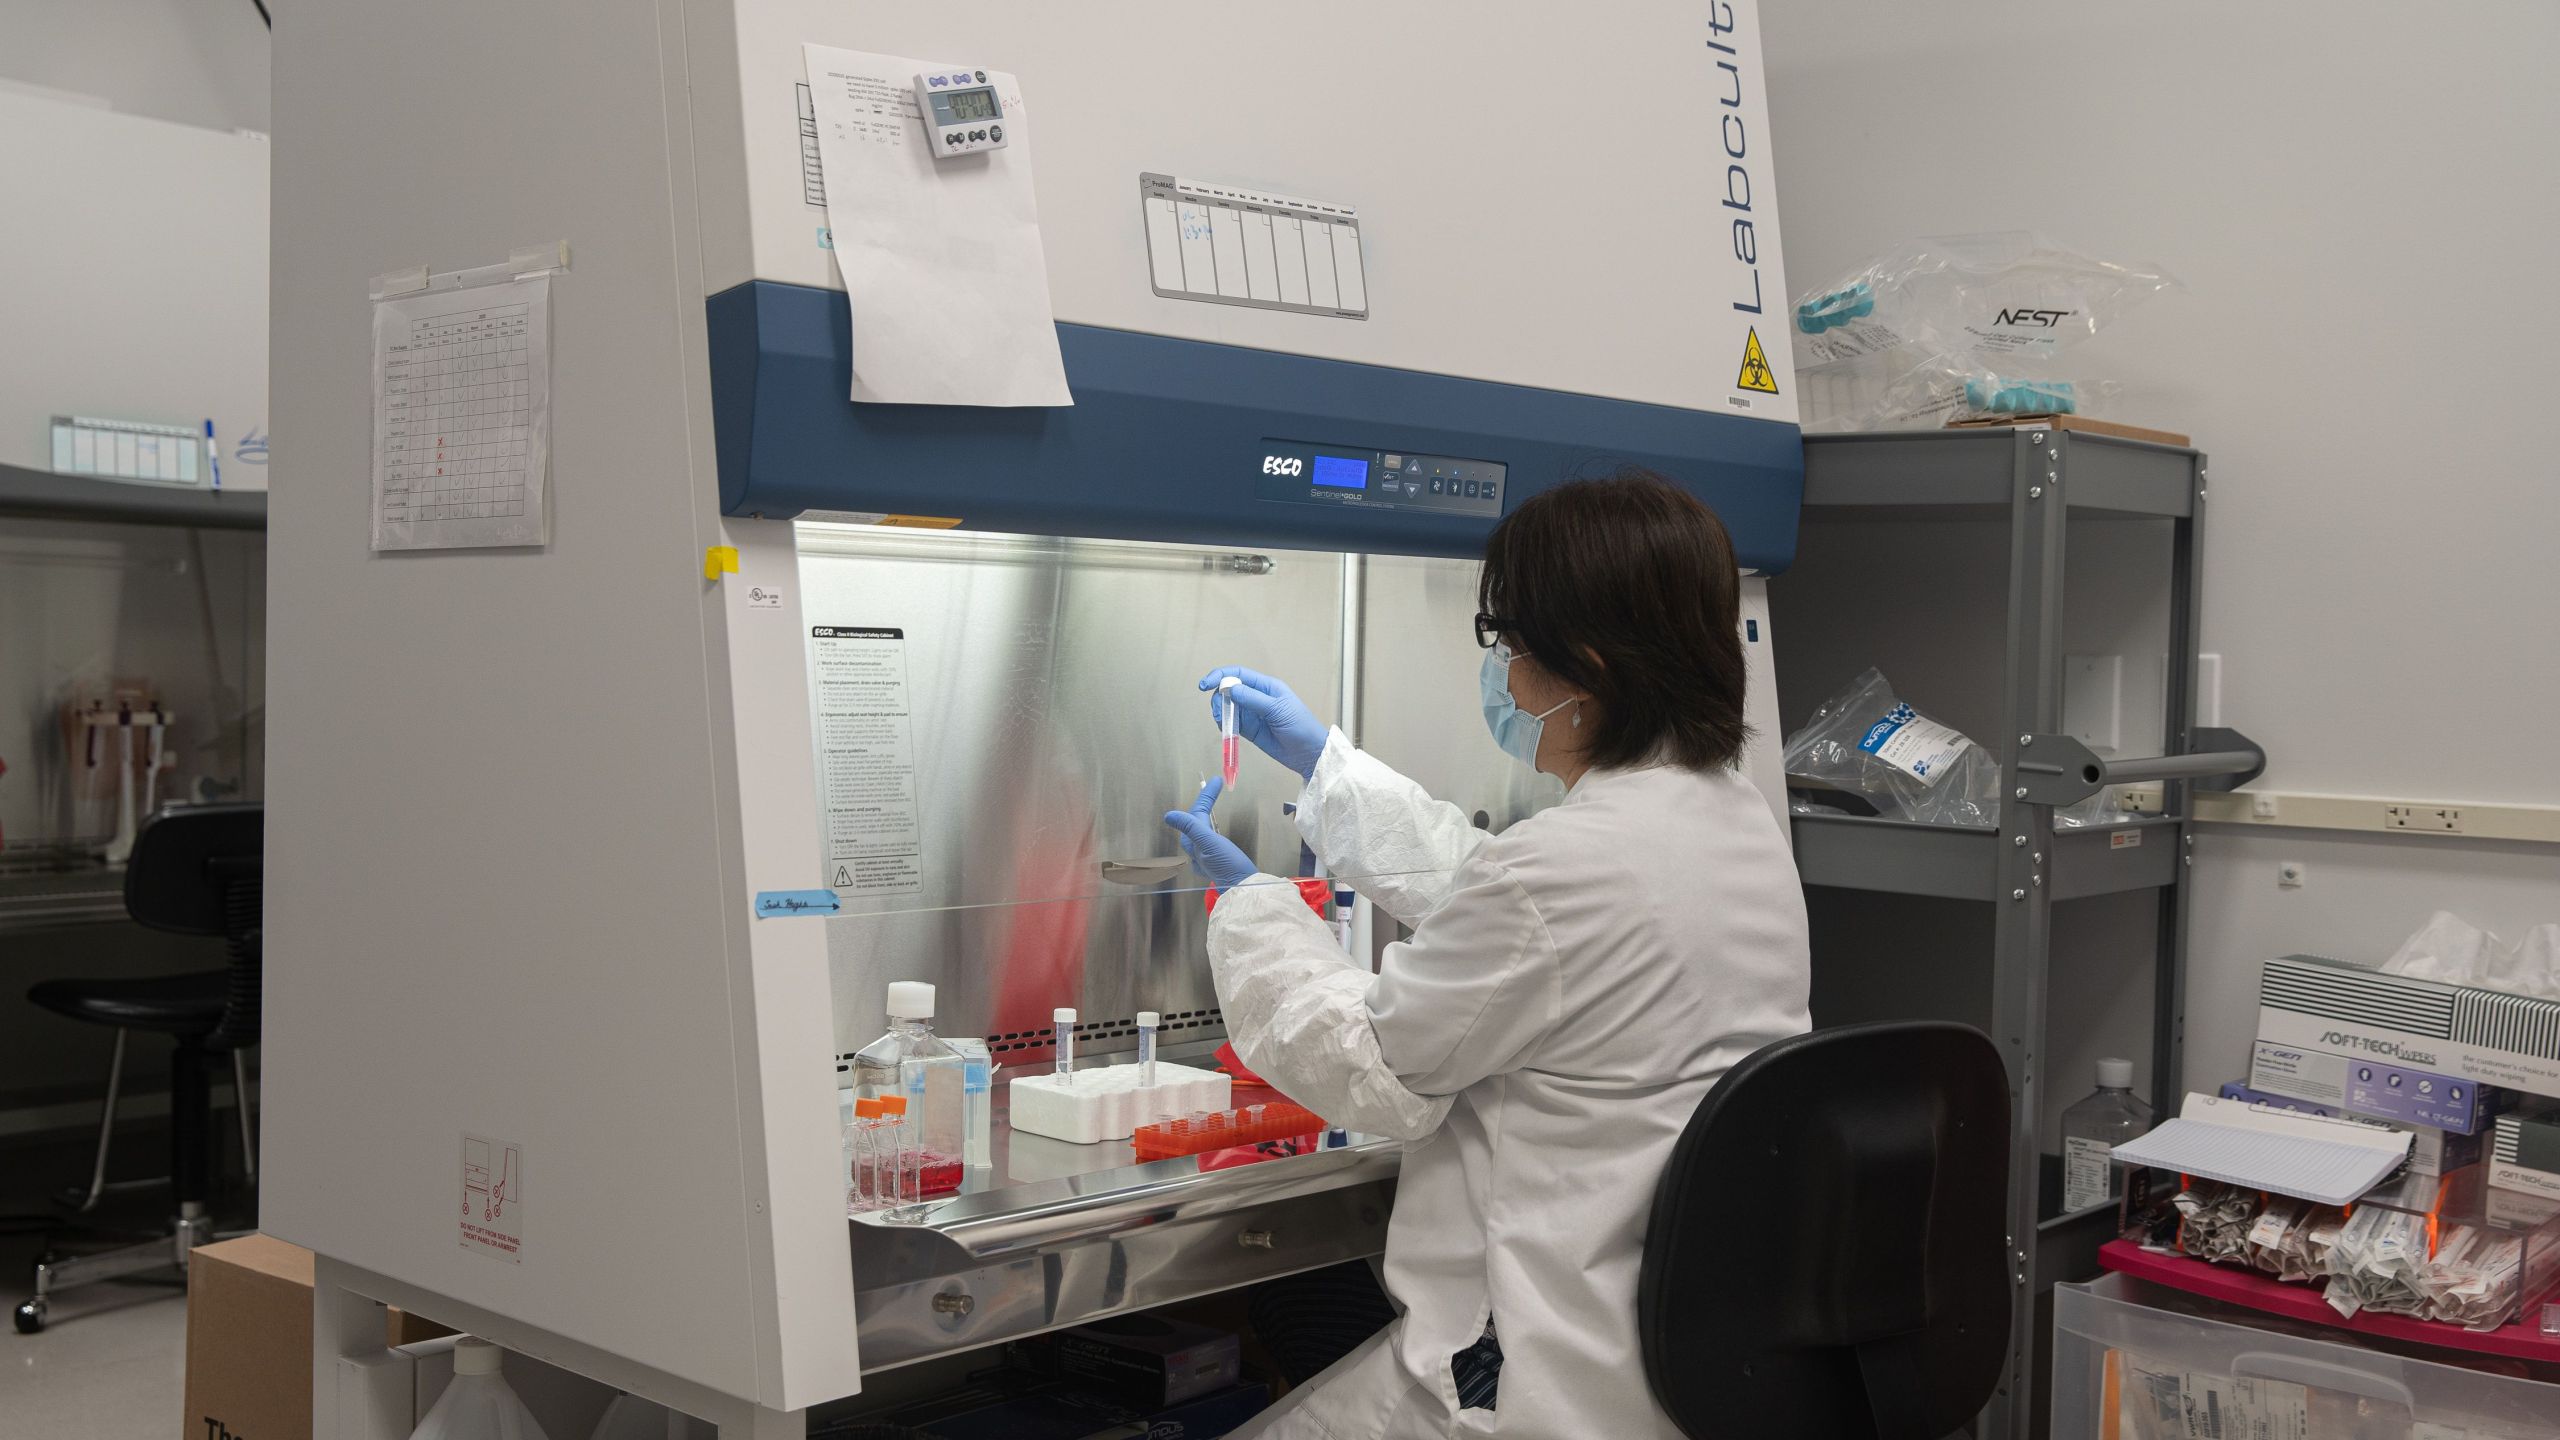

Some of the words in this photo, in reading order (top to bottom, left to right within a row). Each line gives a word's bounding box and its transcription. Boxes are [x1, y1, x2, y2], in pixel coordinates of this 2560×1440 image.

[1152, 180, 1174, 189] ProMAG
[1993, 308, 2069, 328] NEST
[1262, 455, 1302, 477] ESCO
[814, 628, 834, 637] ESCO
[2320, 1031, 2399, 1056] SOFT-TECH
[2462, 1063, 2479, 1073] light
[2480, 1067, 2497, 1077] duty
[2500, 1073, 2527, 1083] wiping
[2463, 1054, 2474, 1062] the
[2477, 1057, 2517, 1070] customer's
[2519, 1065, 2545, 1076] choice
[2547, 1070, 2559, 1079] for
[460, 1221, 467, 1230] DO
[467, 1223, 476, 1232] NOT
[475, 1226, 485, 1235] LIFT
[485, 1229, 497, 1239] FROM
[498, 1231, 507, 1241] SIDE
[508, 1235, 520, 1246] PANEL
[463, 1231, 477, 1241] FRONT
[477, 1235, 491, 1246] PANEL
